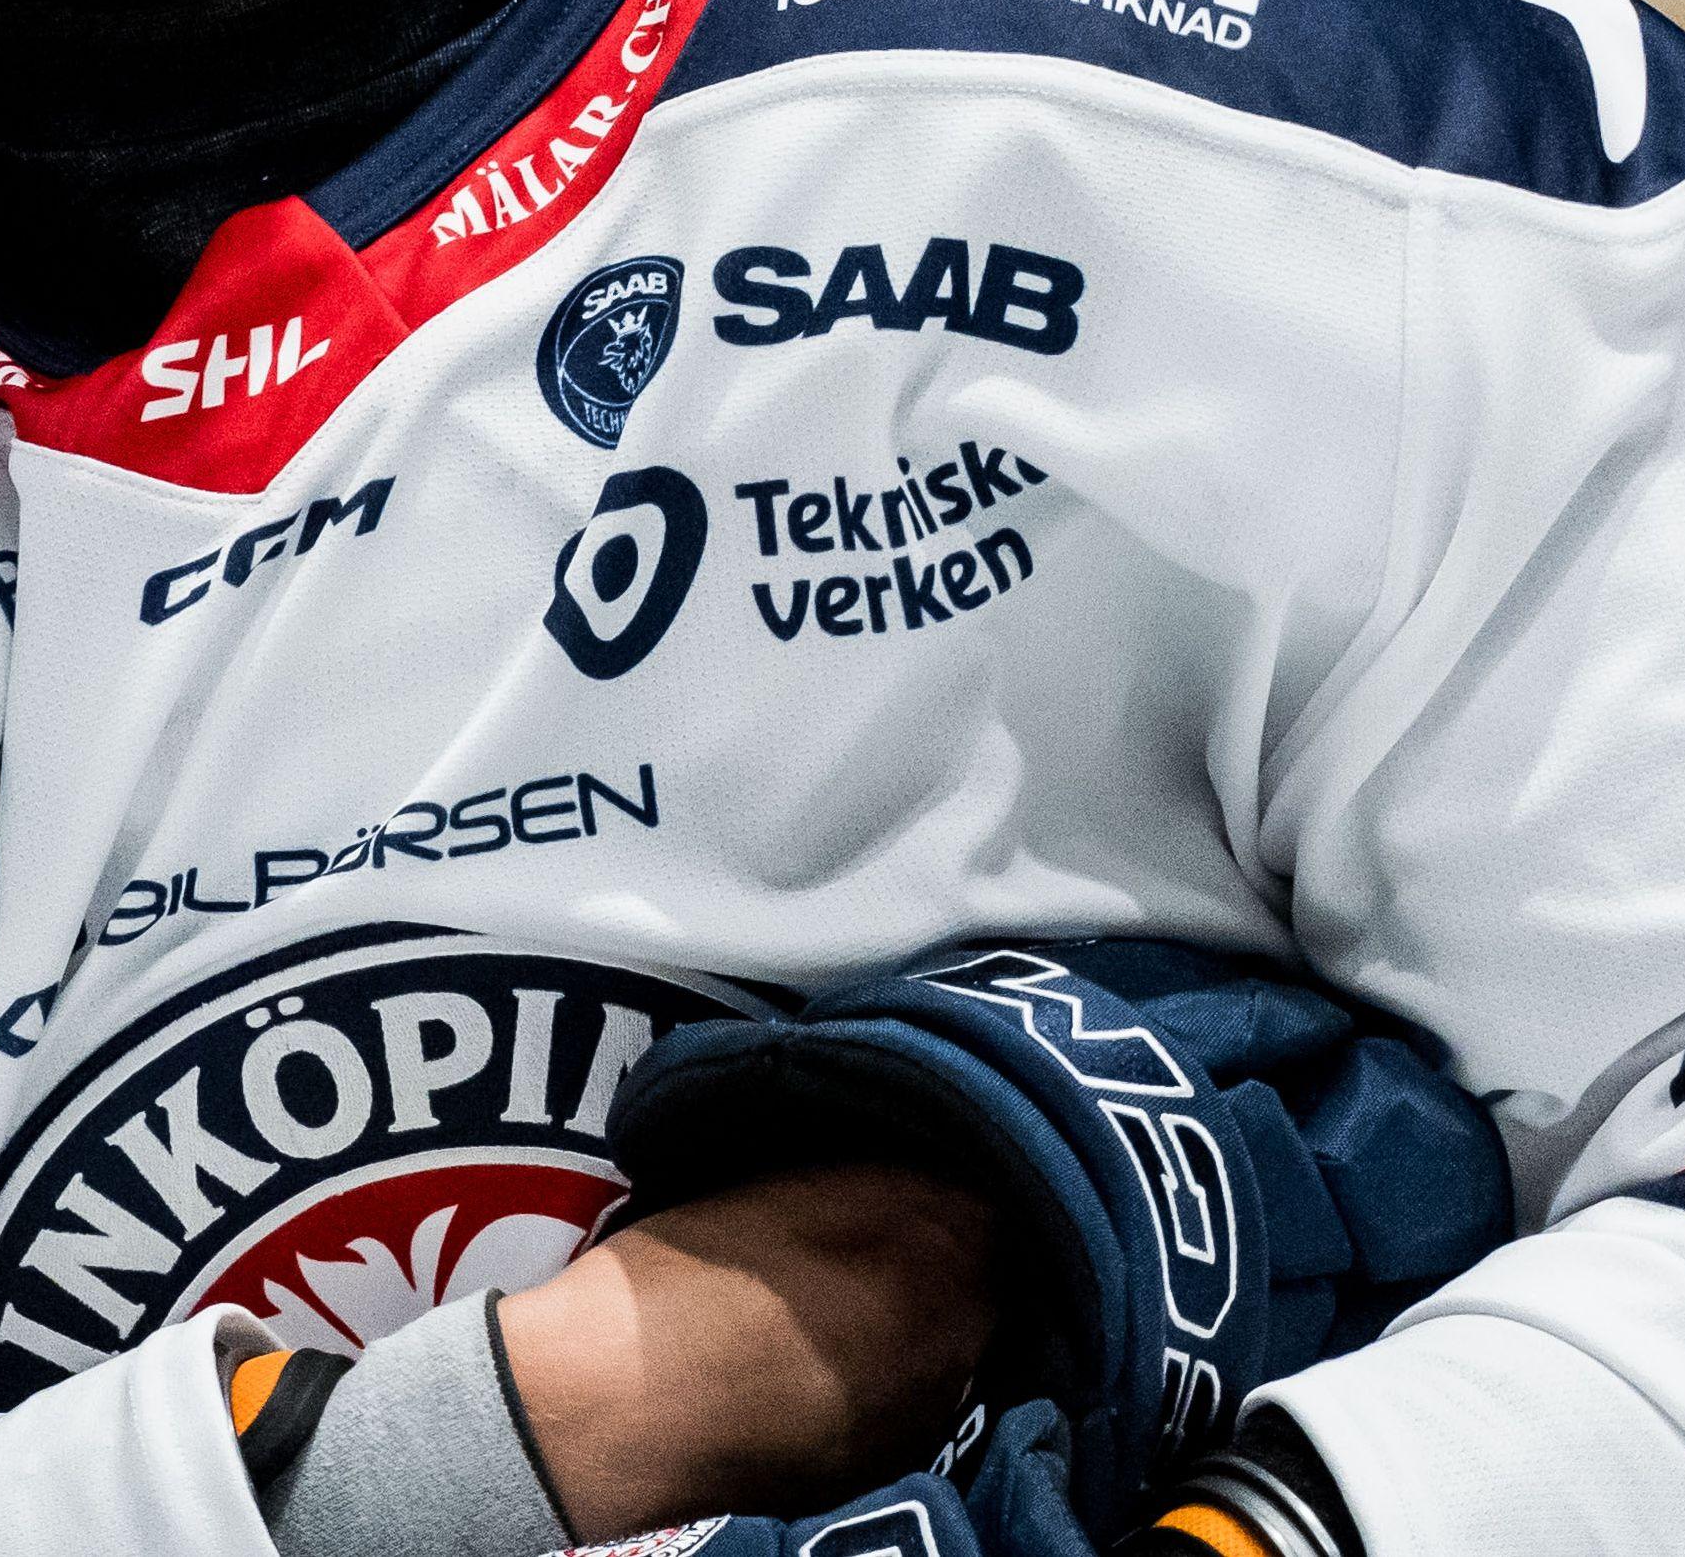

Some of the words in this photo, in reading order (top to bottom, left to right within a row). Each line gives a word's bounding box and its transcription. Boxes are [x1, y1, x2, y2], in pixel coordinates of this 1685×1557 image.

[582, 271, 668, 320] SAAB
[712, 236, 1086, 356] SAAB
[139, 315, 332, 423] SHL
[139, 474, 397, 627] CCM
[751, 527, 1034, 642] verken
